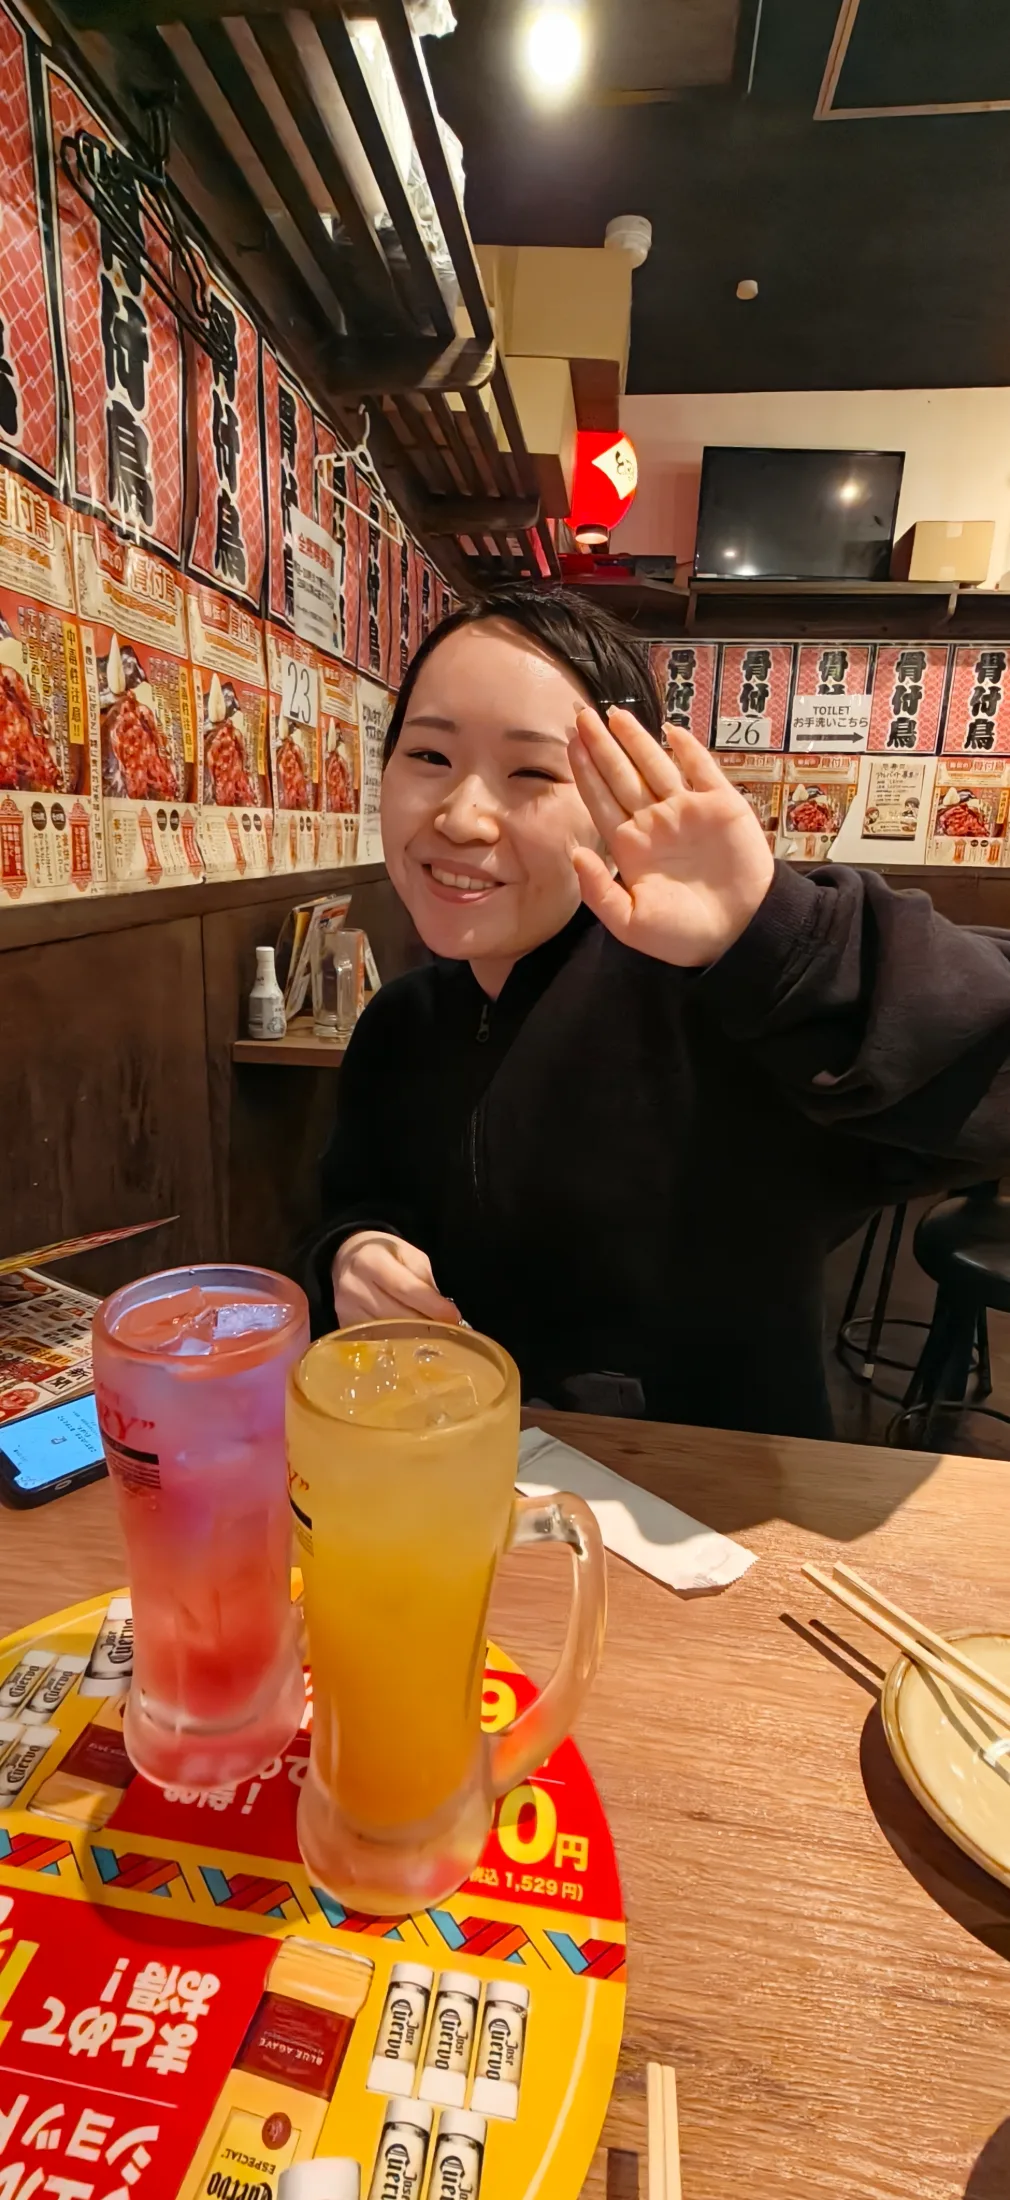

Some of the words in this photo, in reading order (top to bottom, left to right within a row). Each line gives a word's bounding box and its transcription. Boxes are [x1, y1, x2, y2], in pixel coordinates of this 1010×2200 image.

[287, 661, 312, 724] 23
[740, 650, 771, 719] 骨付
[886, 651, 926, 749] 骨付鳥
[964, 651, 1006, 750] 骨付鳥
[793, 717, 869, 729] お手洗いこちら
[813, 706, 850, 716] TOILET
[725, 719, 760, 746] 26
[9, 1665, 40, 1698] Cuervo
[43, 1670, 75, 1704] Cuervo
[7, 1745, 41, 1784] Cuervo
[504, 1871, 558, 1897] 1,529
[21, 1995, 198, 2076] まとめて
[258, 2037, 292, 2055] AGAVE
[385, 1998, 413, 2060] Cuervo
[435, 2008, 462, 2071] Cuervo
[295, 2050, 324, 2066] BLUE
[485, 2018, 512, 2081] Cuervo
[221, 2148, 277, 2176] ESPECIAL
